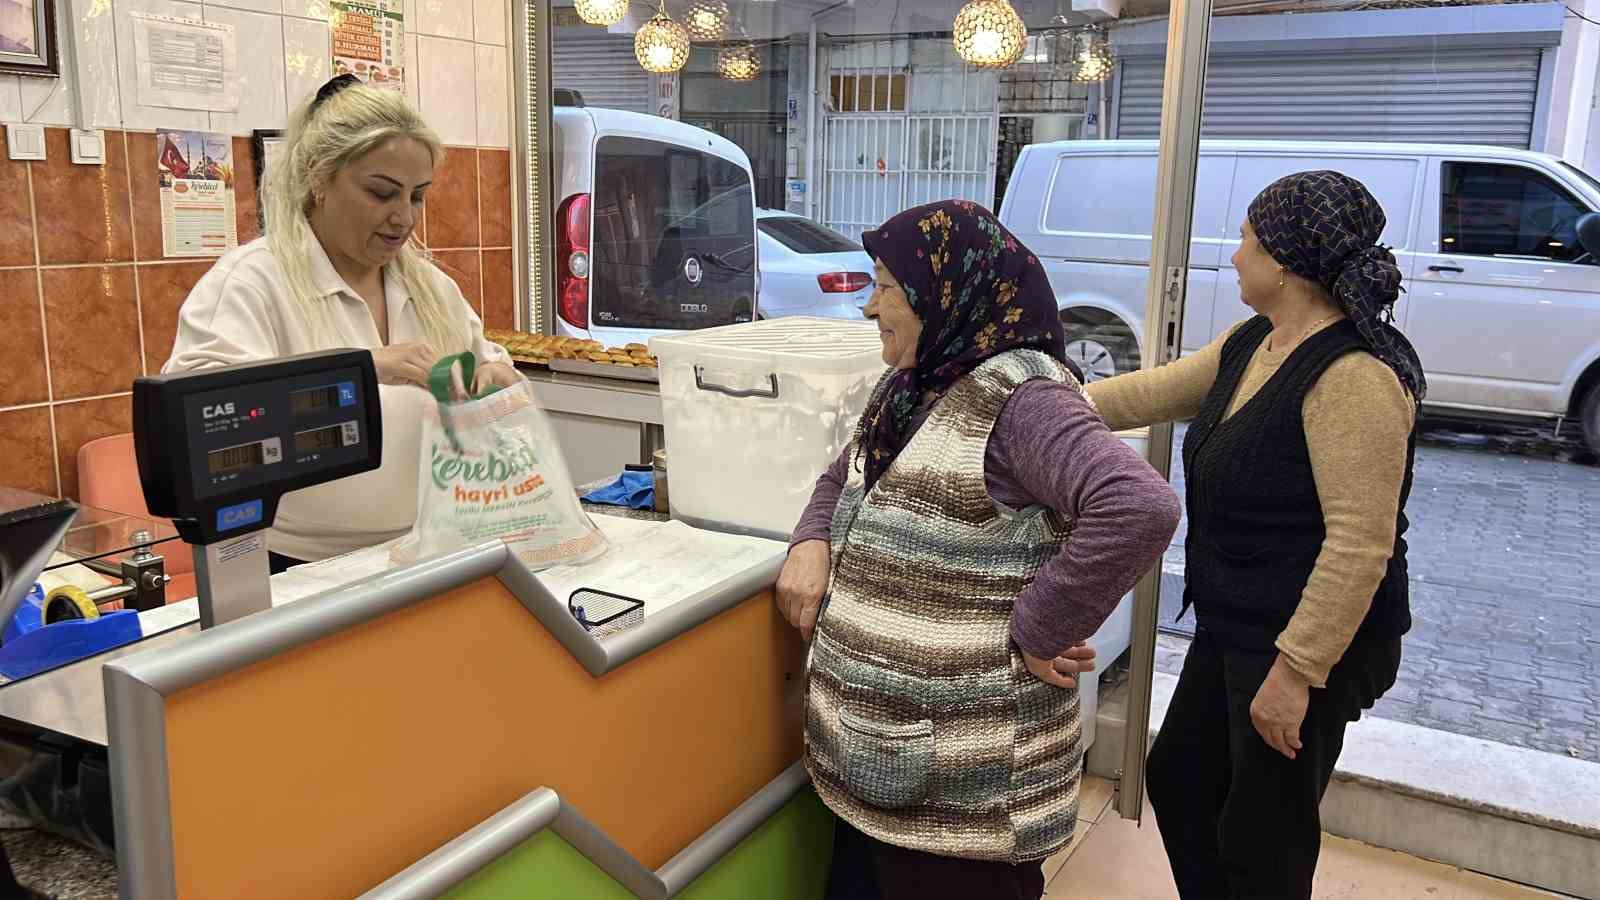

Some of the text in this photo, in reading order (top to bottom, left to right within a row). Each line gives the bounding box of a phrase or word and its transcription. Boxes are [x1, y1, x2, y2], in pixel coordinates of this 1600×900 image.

[203, 402, 235, 418] CAS
[455, 486, 508, 504] hayri
[224, 507, 256, 525] CAS
